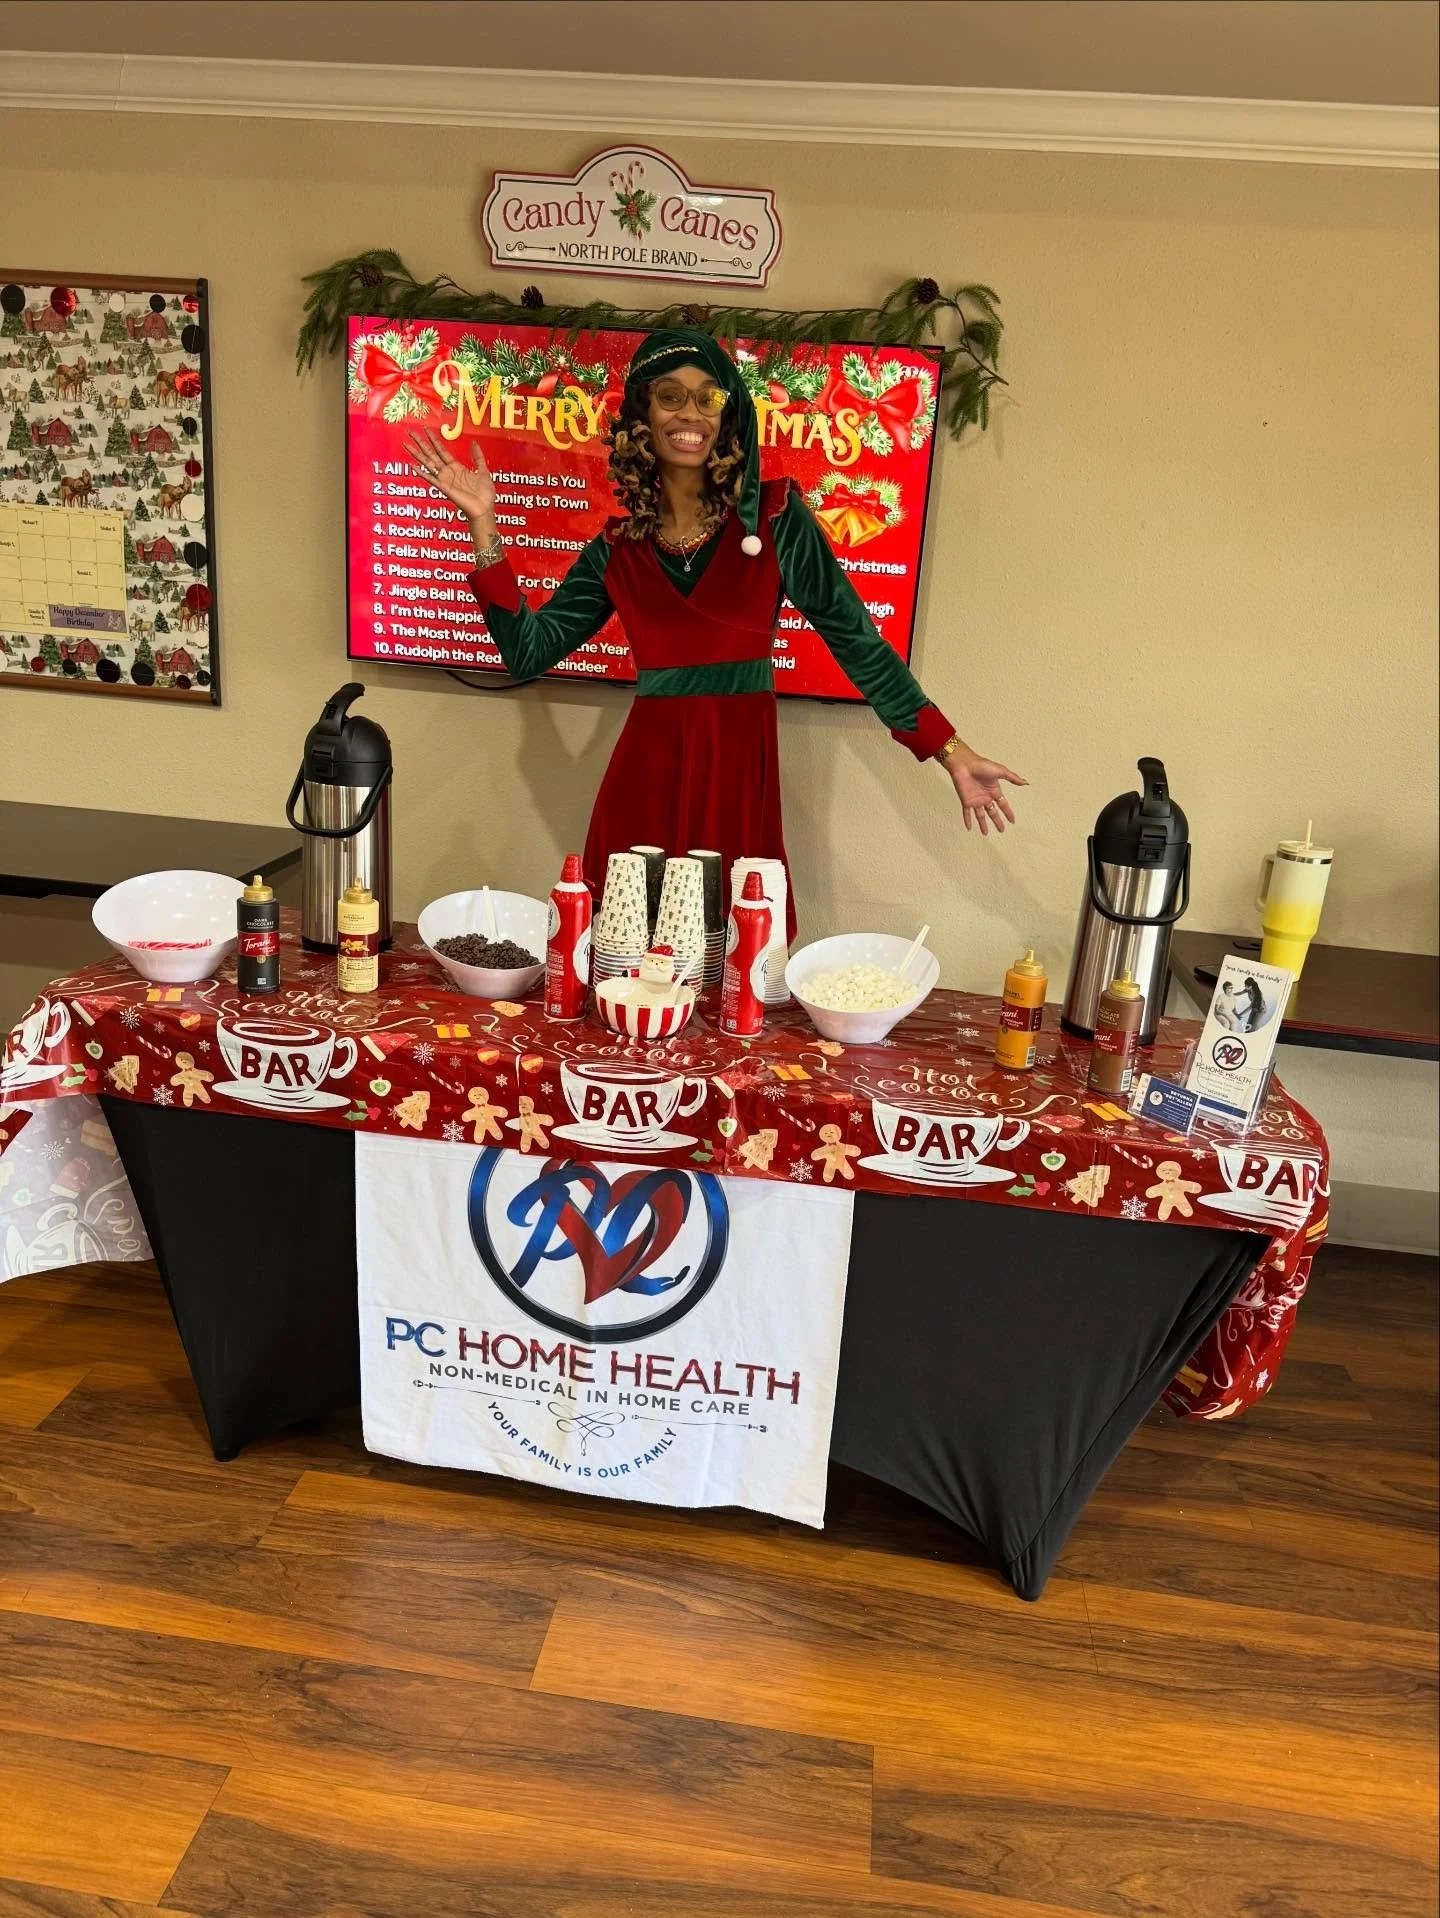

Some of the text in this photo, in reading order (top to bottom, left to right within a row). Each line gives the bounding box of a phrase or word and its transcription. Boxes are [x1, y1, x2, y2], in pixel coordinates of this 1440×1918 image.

[502, 191, 759, 250] Candy Canes
[558, 242, 697, 267] NORTH POLE BRAND
[373, 461, 383, 474] 1.
[385, 462, 402, 475] All
[547, 473, 558, 486] Is
[561, 475, 586, 489] You
[373, 481, 385, 494] 2.
[387, 482, 426, 497] Santa
[494, 491, 534, 508] oming
[535, 494, 550, 507] to
[552, 495, 589, 510] Town
[372, 502, 385, 515] 3.
[387, 503, 422, 520] Holly
[423, 506, 455, 523] Jolly
[373, 522, 386, 535] 4.
[438, 528, 473, 542] Arou
[516, 534, 585, 551] Christmas
[373, 543, 385, 555] 5.
[387, 544, 418, 558] Feliz
[373, 563, 386, 575] 6.
[388, 564, 431, 579] Please
[517, 575, 540, 588] For
[372, 582, 477, 603] 7. Jingle Bell Ro
[53, 606, 73, 616] Happy
[75, 607, 105, 618] December
[66, 619, 95, 629] Birthday
[373, 602, 485, 624] 8. I'm the Happie
[373, 622, 386, 634] 9.
[391, 624, 415, 637] The
[418, 626, 450, 640] Most
[600, 642, 630, 655] Year
[373, 642, 392, 654] 10.
[394, 643, 449, 661] Rudolph
[452, 646, 474, 661] the
[554, 658, 609, 673] eindeer
[771, 656, 796, 669] hild
[243, 936, 272, 952] Torani
[285, 990, 361, 1013] Hot
[240, 1044, 317, 1087] BAR
[898, 1064, 982, 1091] Hot
[1205, 1066, 1224, 1076] HOME
[1225, 1073, 1251, 1084] HEALTH
[582, 1085, 664, 1127] BAR
[891, 1115, 980, 1160] BAR
[386, 1316, 800, 1404] PC HOME HEALTH
[429, 1362, 750, 1415] NON-MEDICAL IN HOME CARE
[488, 1401, 677, 1478] YOUR FAMILY IS OUR FAMILY
